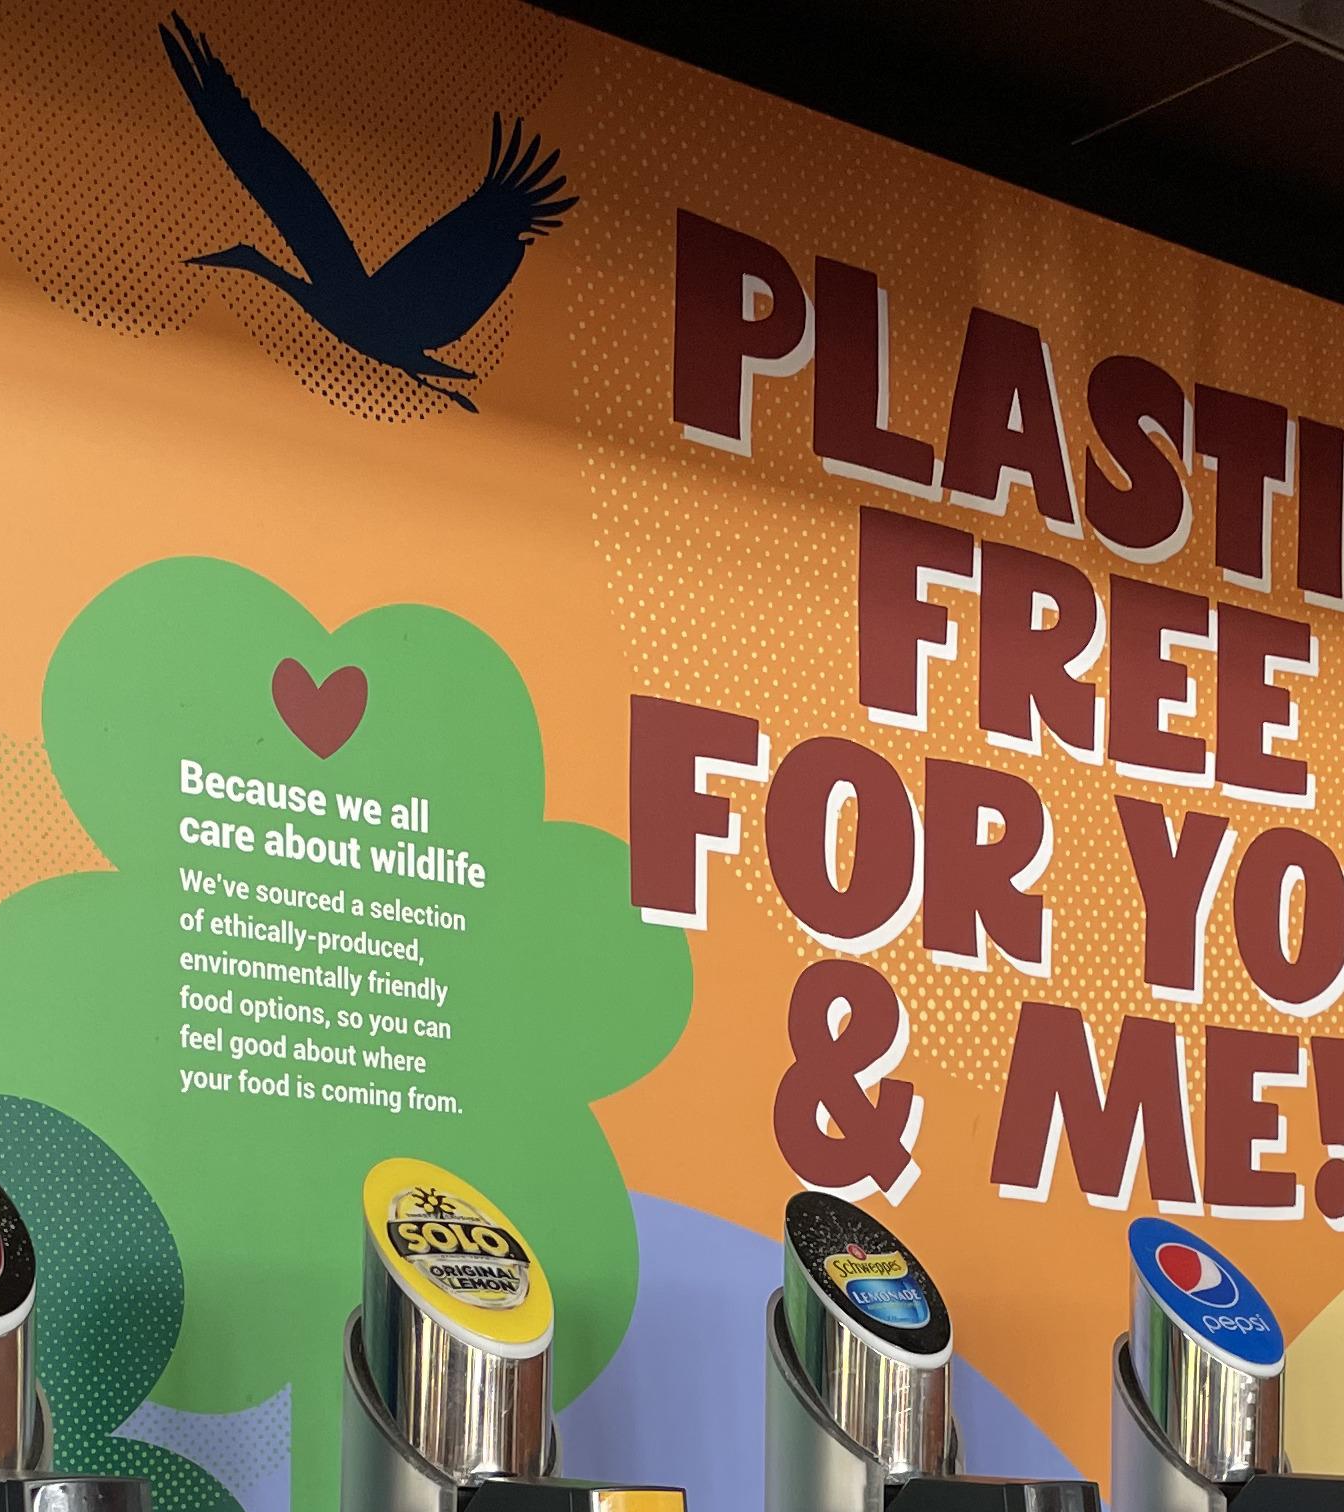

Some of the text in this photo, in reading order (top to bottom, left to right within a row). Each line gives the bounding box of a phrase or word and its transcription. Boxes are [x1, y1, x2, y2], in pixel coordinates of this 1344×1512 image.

[858, 506, 1318, 809] FREE
[180, 759, 428, 833] Because we all
[180, 817, 486, 888] care about wildlife
[630, 694, 1053, 977] FOR
[180, 868, 465, 931] We've sourced a selection
[180, 908, 425, 965] of ethically-produced,
[180, 951, 448, 1007] environmentally friendly
[180, 985, 451, 1039] food options, so you can
[180, 1024, 426, 1073] feel good about where
[180, 1068, 463, 1114] your food is coming from.
[773, 958, 923, 1204] &
[399, 1222, 509, 1257] SOLO
[430, 1265, 519, 1280] ORIGINAL
[449, 1278, 518, 1292] LEMON
[833, 1259, 901, 1278] Schweppes
[852, 1289, 921, 1304] LEMONADE
[1203, 1314, 1270, 1334] pepsi
